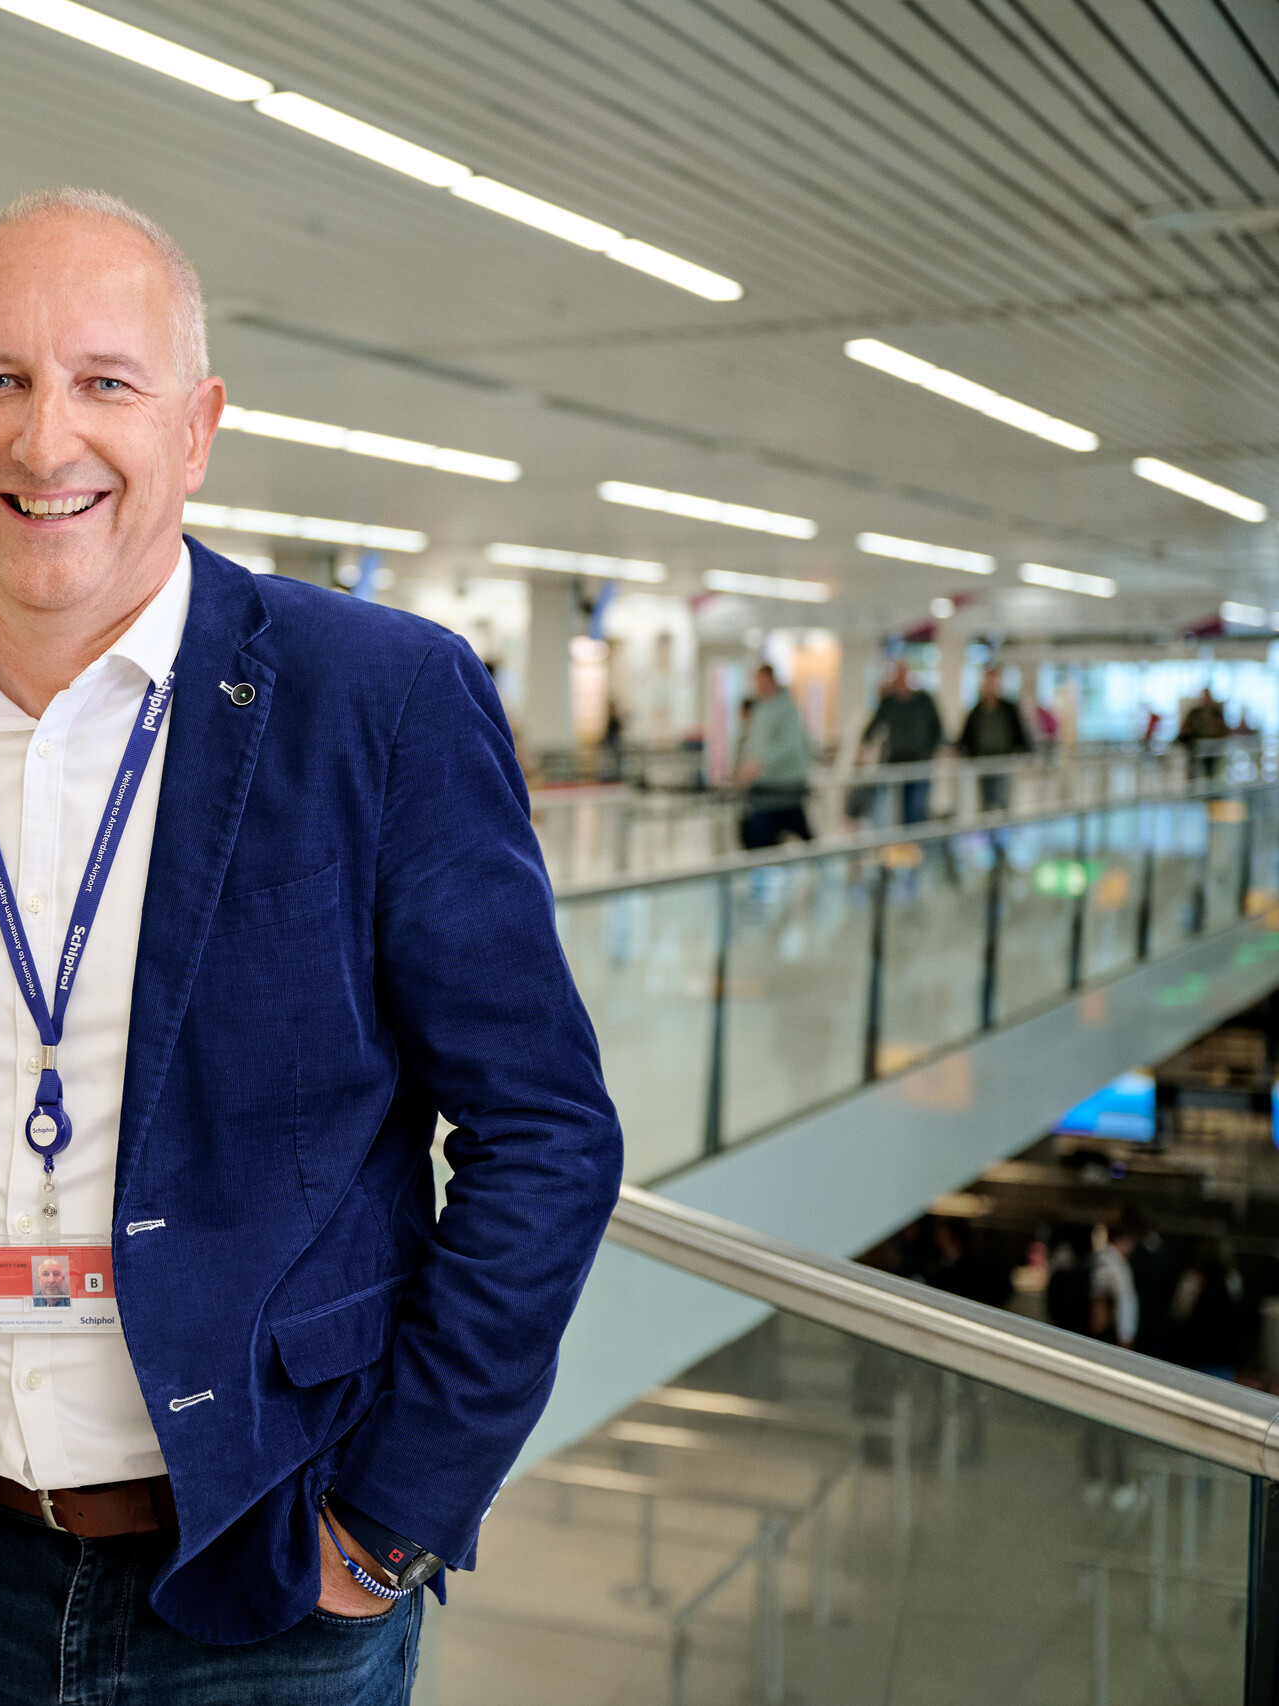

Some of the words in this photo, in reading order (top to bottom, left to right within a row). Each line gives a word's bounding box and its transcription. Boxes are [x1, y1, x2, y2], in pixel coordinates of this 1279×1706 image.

[114, 769, 134, 806] Welcome
[111, 806, 120, 816] to
[96, 816, 117, 862] Amsterdam
[85, 862, 101, 893] Airport
[4, 905, 23, 950] Amsterdam
[18, 950, 25, 961] to
[59, 924, 86, 991] Schiphol
[21, 960, 37, 999] Welcome
[90, 1278, 99, 1288] B
[80, 1316, 115, 1327] Schiphol
